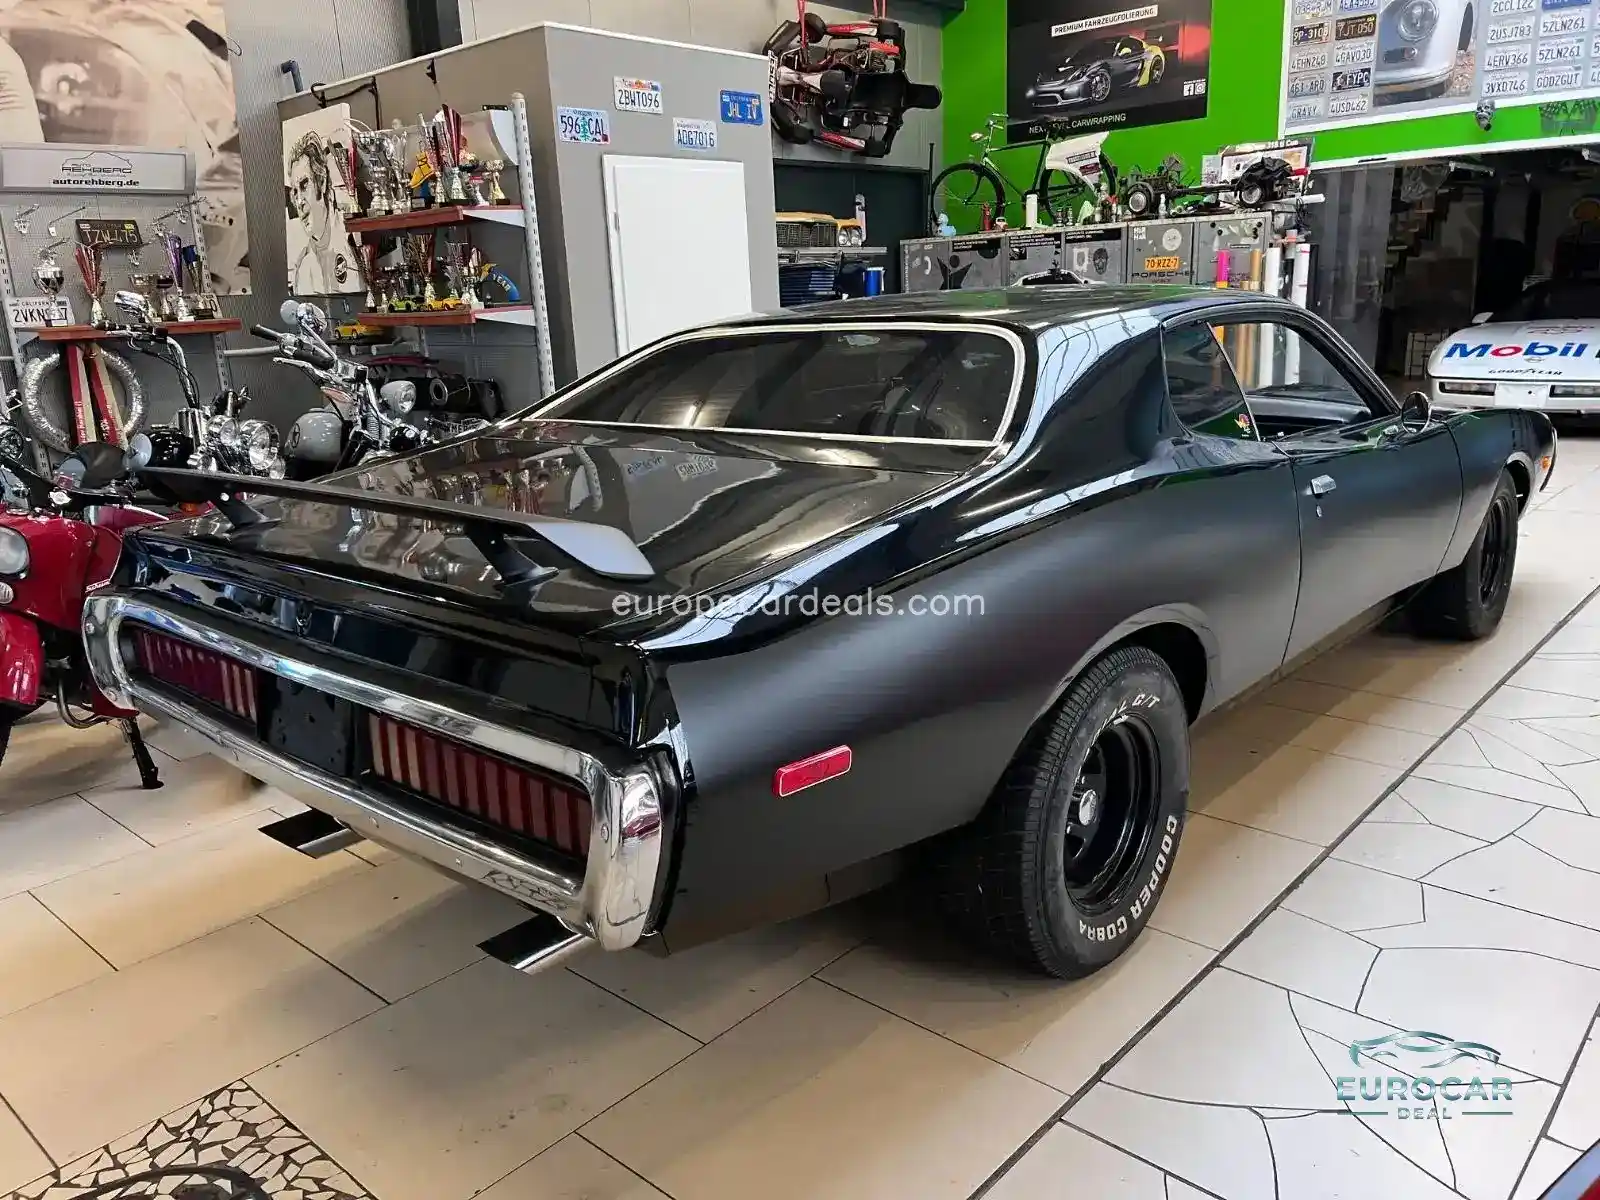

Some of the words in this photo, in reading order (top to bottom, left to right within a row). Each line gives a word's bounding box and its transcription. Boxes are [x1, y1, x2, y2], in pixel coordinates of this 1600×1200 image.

[1054, 23, 1083, 34] PREMIUM
[1084, 8, 1154, 28] FAHRZEUGFOLIERUNG
[560, 114, 581, 134] 596
[587, 117, 604, 136] CAL
[1029, 125, 1046, 134] NEX
[1071, 113, 1126, 128] CARWRAPPING
[52, 178, 140, 187] autorehberg.de
[13, 308, 67, 323] 2VKN7
[1444, 341, 1589, 358] Mobil
[1131, 693, 1161, 709] G/T
[1130, 815, 1178, 920] COOPER
[1079, 915, 1128, 942] COBRA
